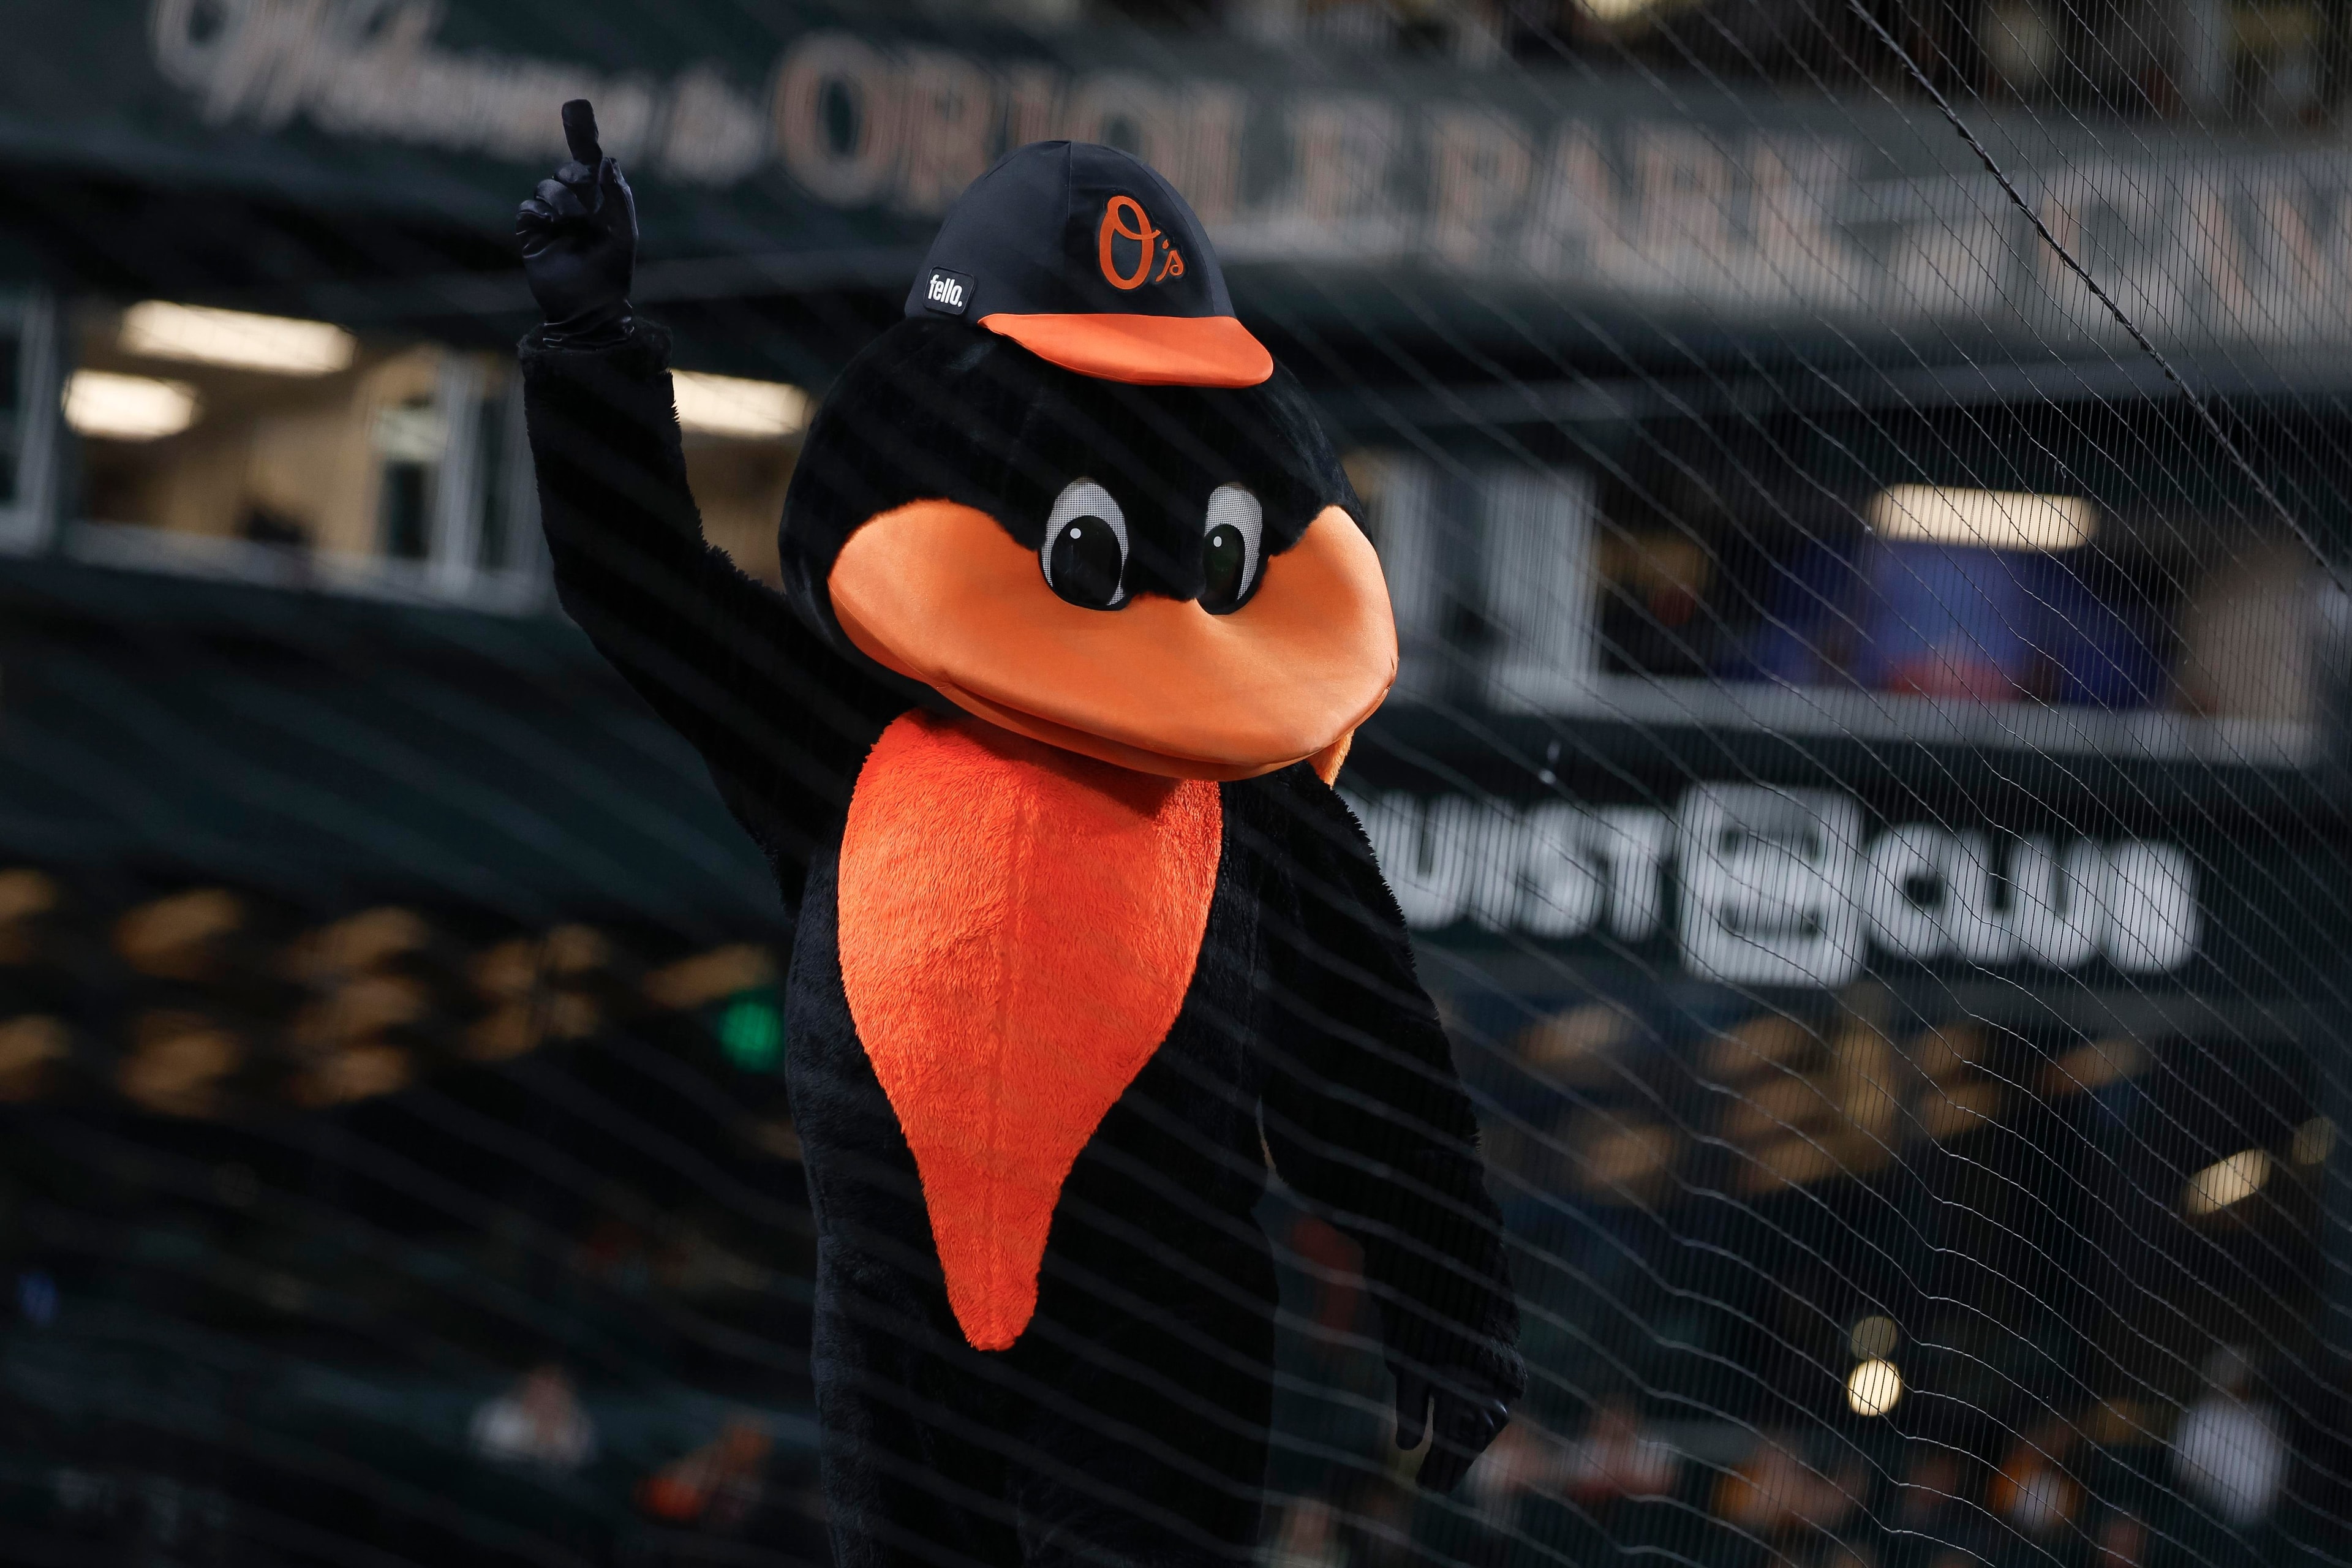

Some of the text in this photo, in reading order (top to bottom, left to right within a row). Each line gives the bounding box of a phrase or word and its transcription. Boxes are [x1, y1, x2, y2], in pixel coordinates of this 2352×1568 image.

[1099, 195, 1184, 290] O's
[1416, 109, 1847, 300] PARK
[927, 274, 963, 307] fello.
